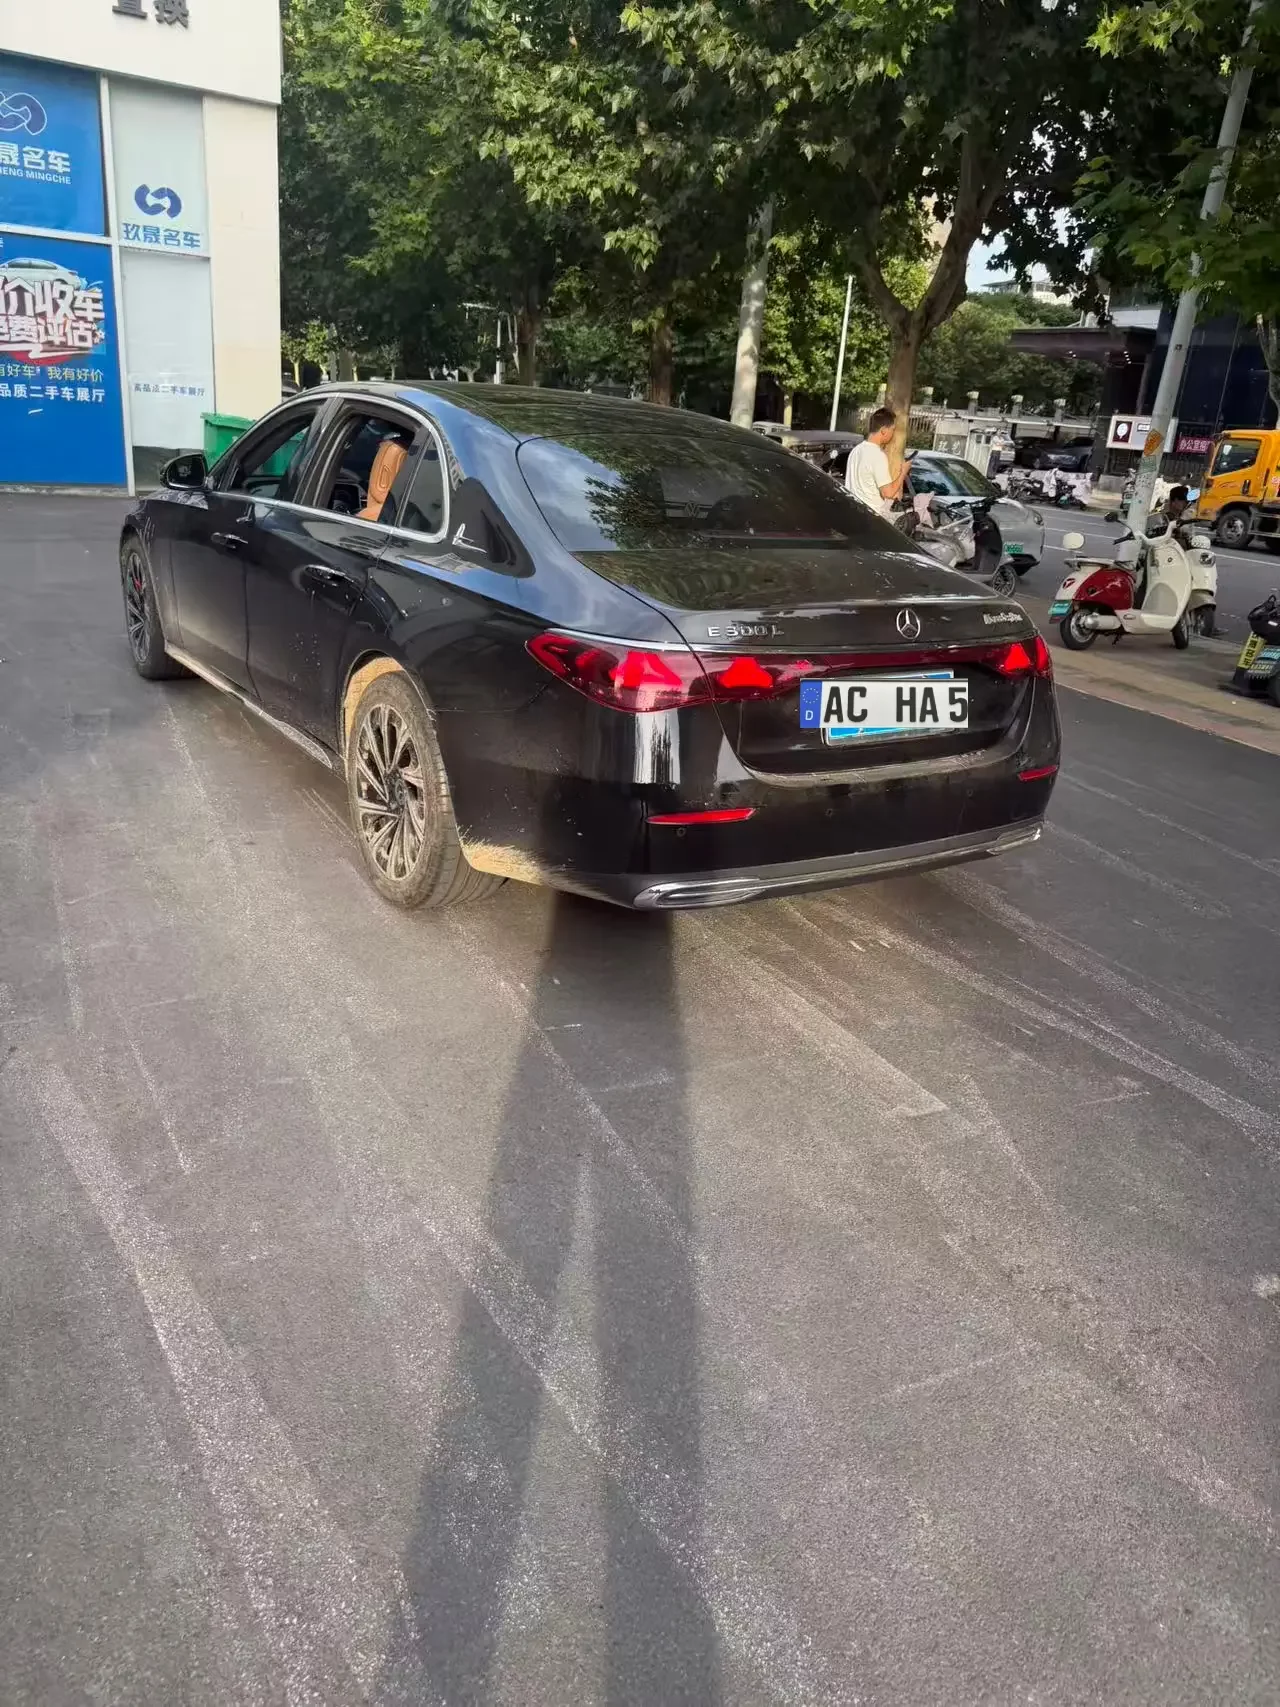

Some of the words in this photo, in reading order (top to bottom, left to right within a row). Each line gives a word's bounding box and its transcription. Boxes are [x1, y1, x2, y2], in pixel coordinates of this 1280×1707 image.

[26, 170, 72, 185] MINGCHE
[122, 223, 201, 248] 玖晟名车
[823, 686, 868, 723] AC
[895, 686, 940, 723] HA
[948, 687, 968, 723] 5
[805, 710, 814, 721] D
